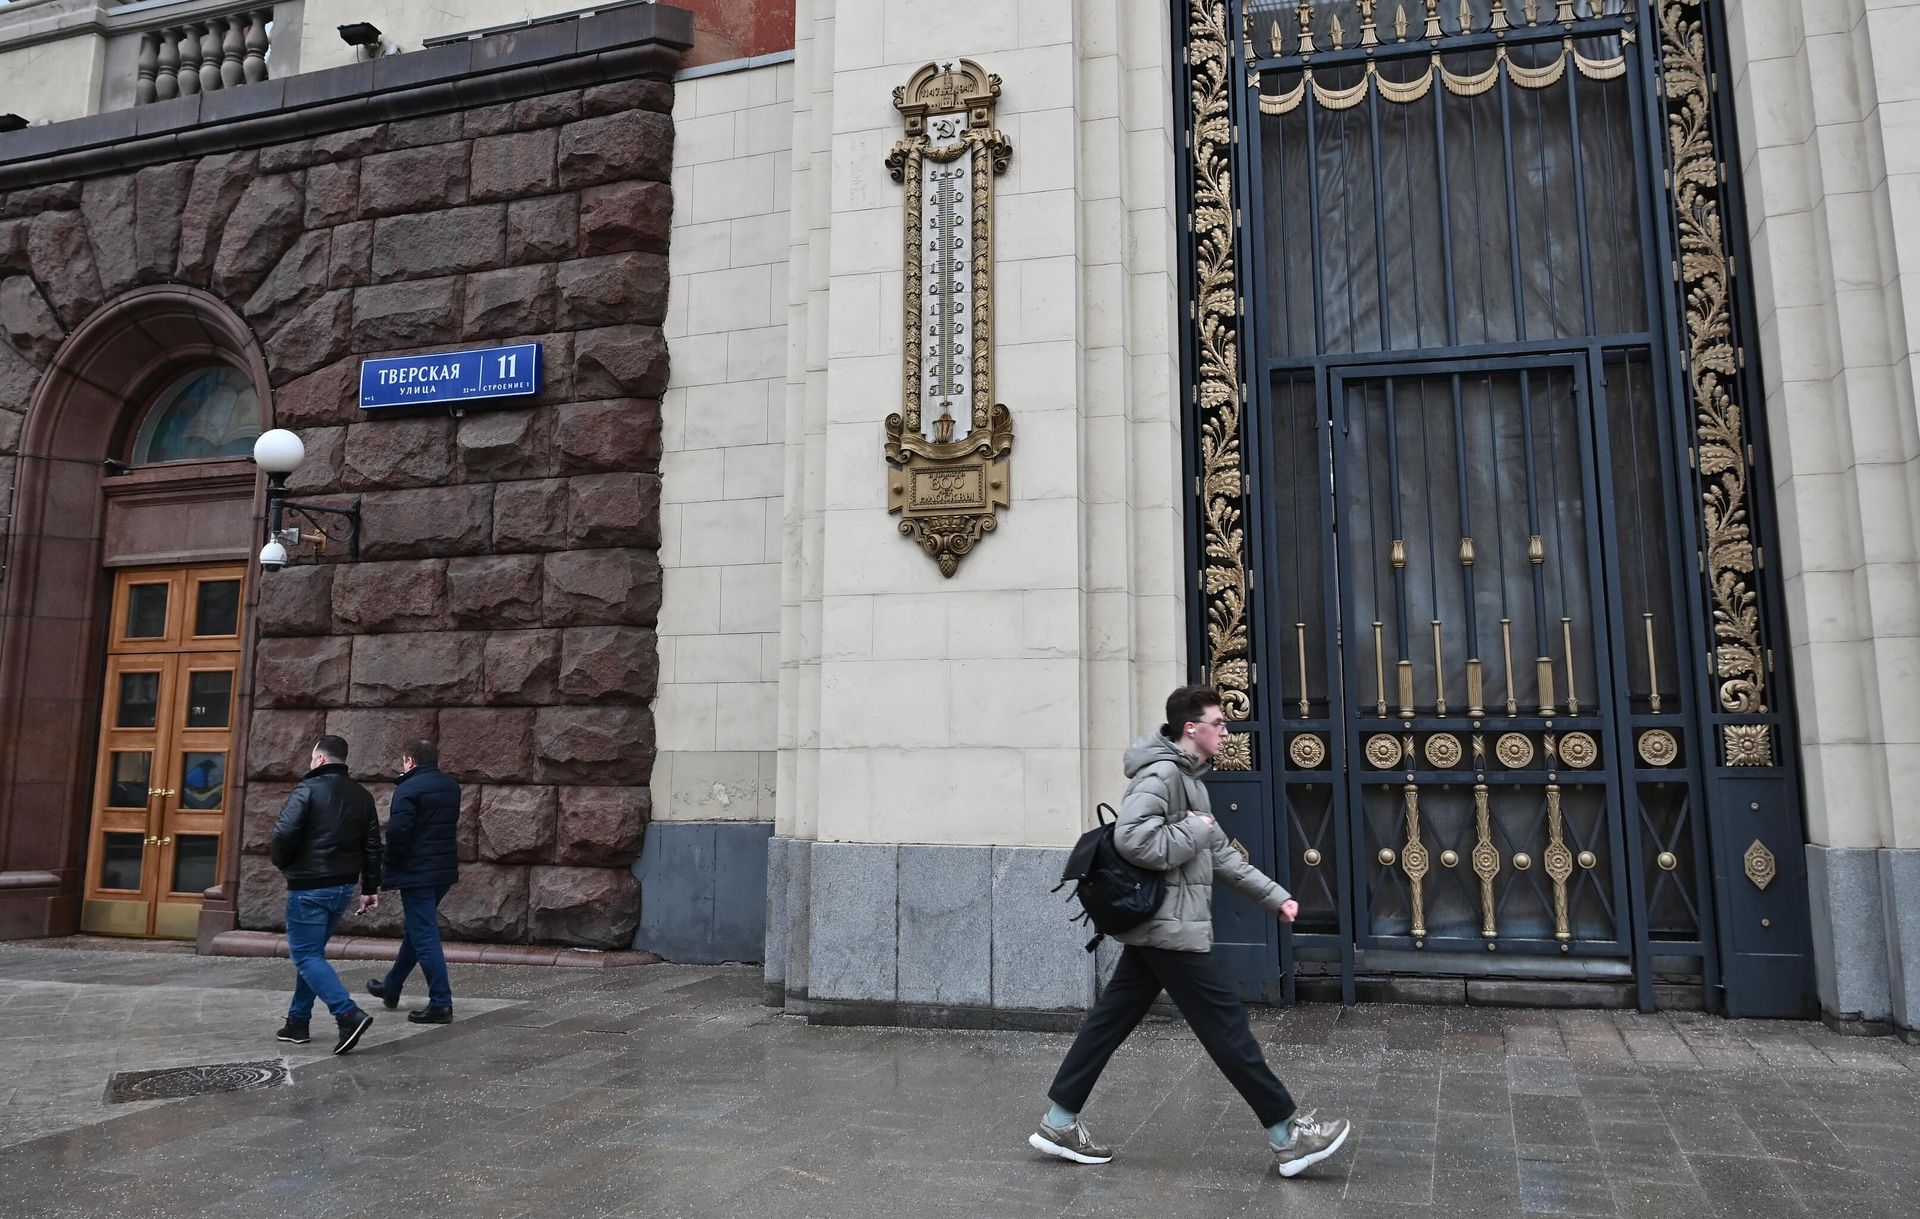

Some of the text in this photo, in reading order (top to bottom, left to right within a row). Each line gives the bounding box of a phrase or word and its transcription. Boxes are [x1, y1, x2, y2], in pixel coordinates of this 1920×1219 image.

[498, 353, 517, 379] 11
[379, 363, 460, 385] ТВЕРСКАЯ
[400, 386, 436, 395] УЛИЦА
[483, 382, 524, 392] СТРОЕНИЕ
[930, 477, 964, 490] 800
